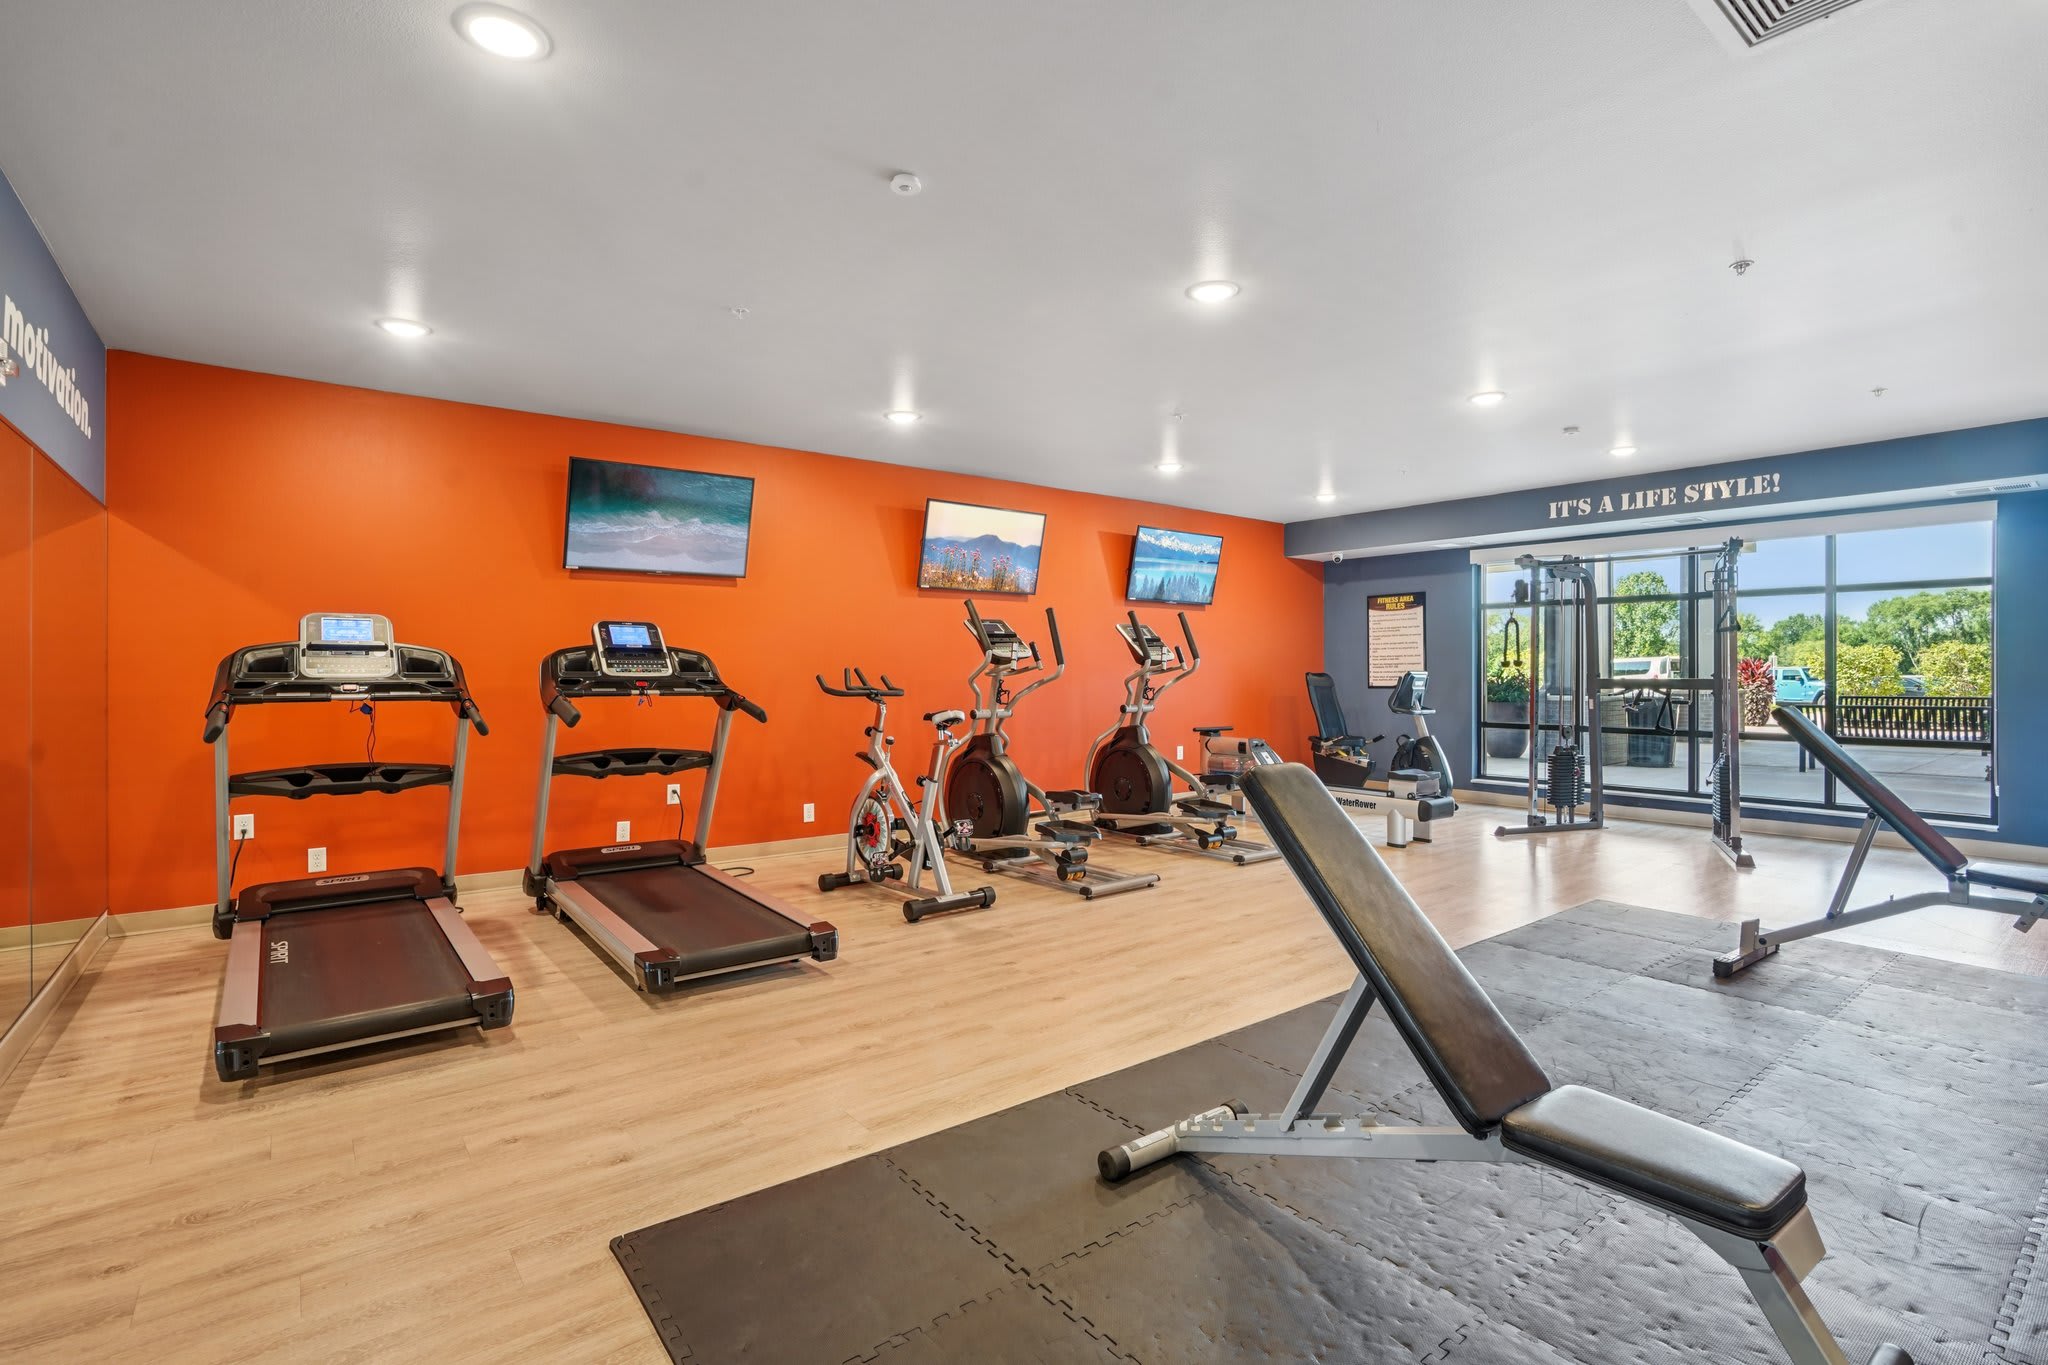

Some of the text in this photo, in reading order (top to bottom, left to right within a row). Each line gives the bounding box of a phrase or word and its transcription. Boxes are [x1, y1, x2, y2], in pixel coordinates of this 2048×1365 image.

[3, 294, 92, 440] motivation.
[1549, 473, 1781, 520] IT'S A LIFE STYLE!
[1377, 596, 1399, 604] FITNESS
[1385, 602, 1405, 610] RULES
[1335, 797, 1377, 809] WaterRower
[321, 876, 361, 885] SPIRIT
[270, 940, 289, 964] SPIRIT
